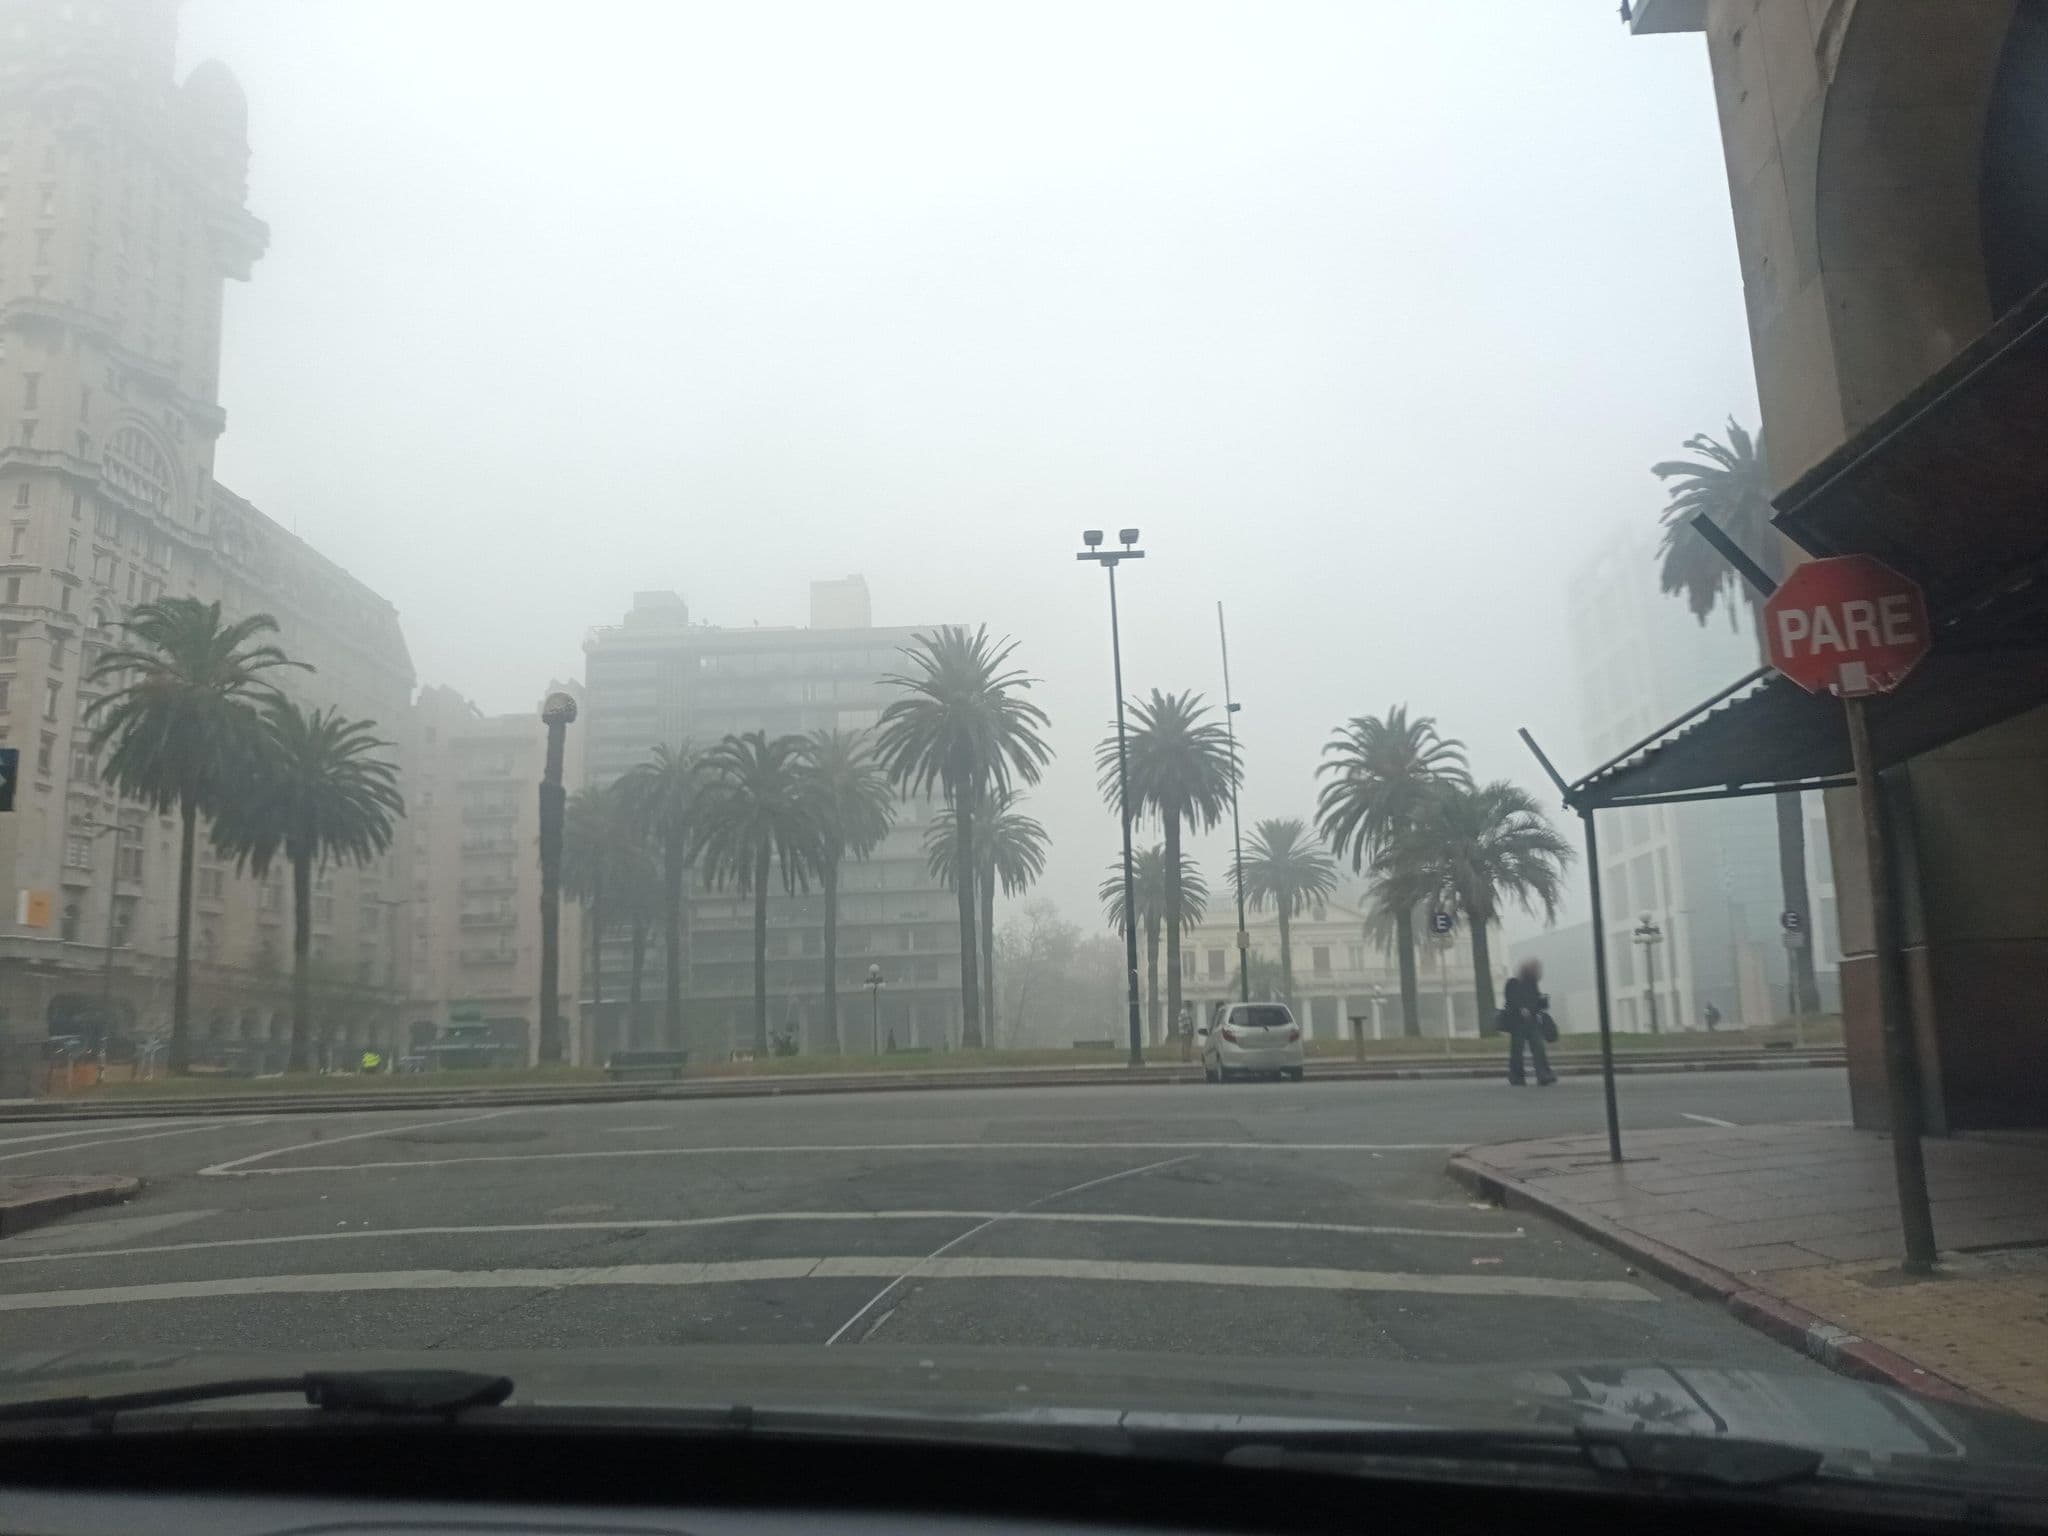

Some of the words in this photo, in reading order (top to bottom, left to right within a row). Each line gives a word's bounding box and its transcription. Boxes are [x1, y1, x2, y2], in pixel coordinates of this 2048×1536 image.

[1776, 594, 1917, 658] PARE
[1436, 915, 1447, 929] E
[1786, 912, 1798, 927] E
